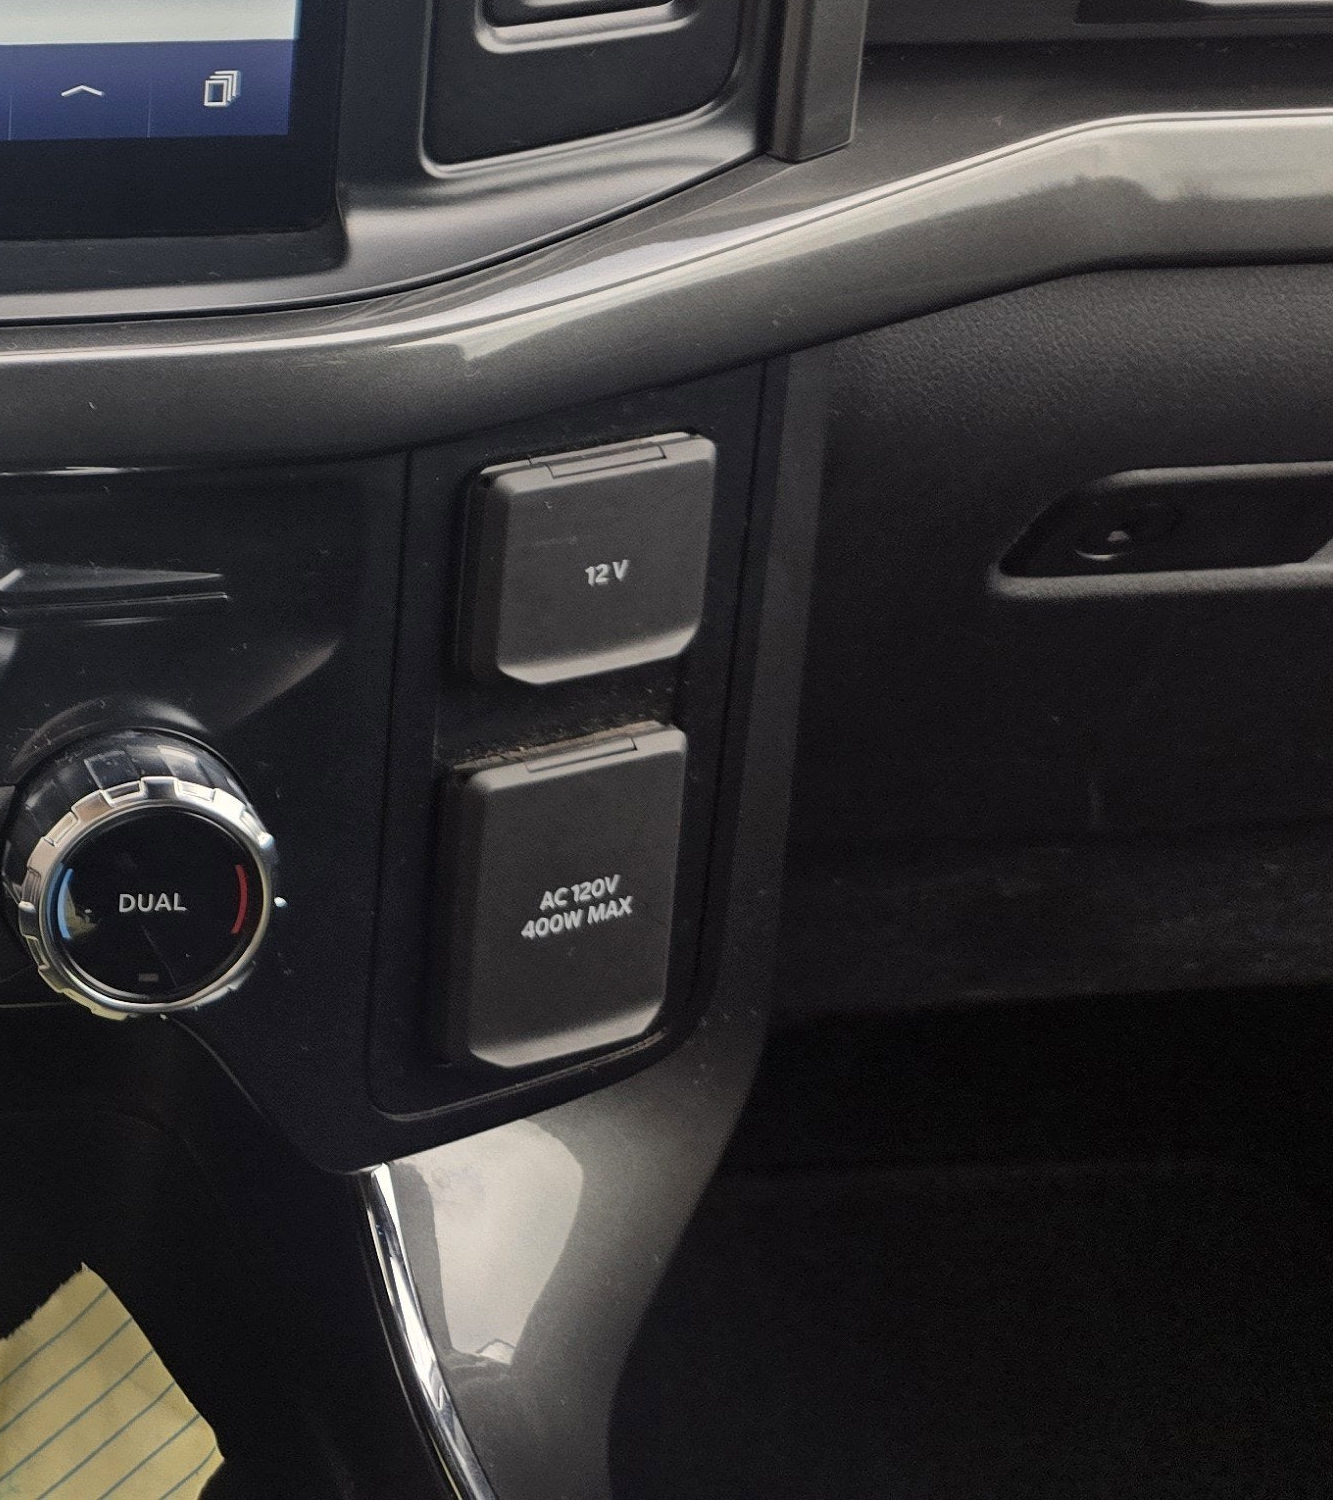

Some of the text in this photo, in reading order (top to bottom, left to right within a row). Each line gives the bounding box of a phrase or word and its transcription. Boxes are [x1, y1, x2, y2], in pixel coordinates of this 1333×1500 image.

[585, 560, 628, 587] 12 V
[118, 893, 187, 914] DUAL
[539, 874, 622, 912] AC 120V
[521, 897, 633, 940] 400W MAX
